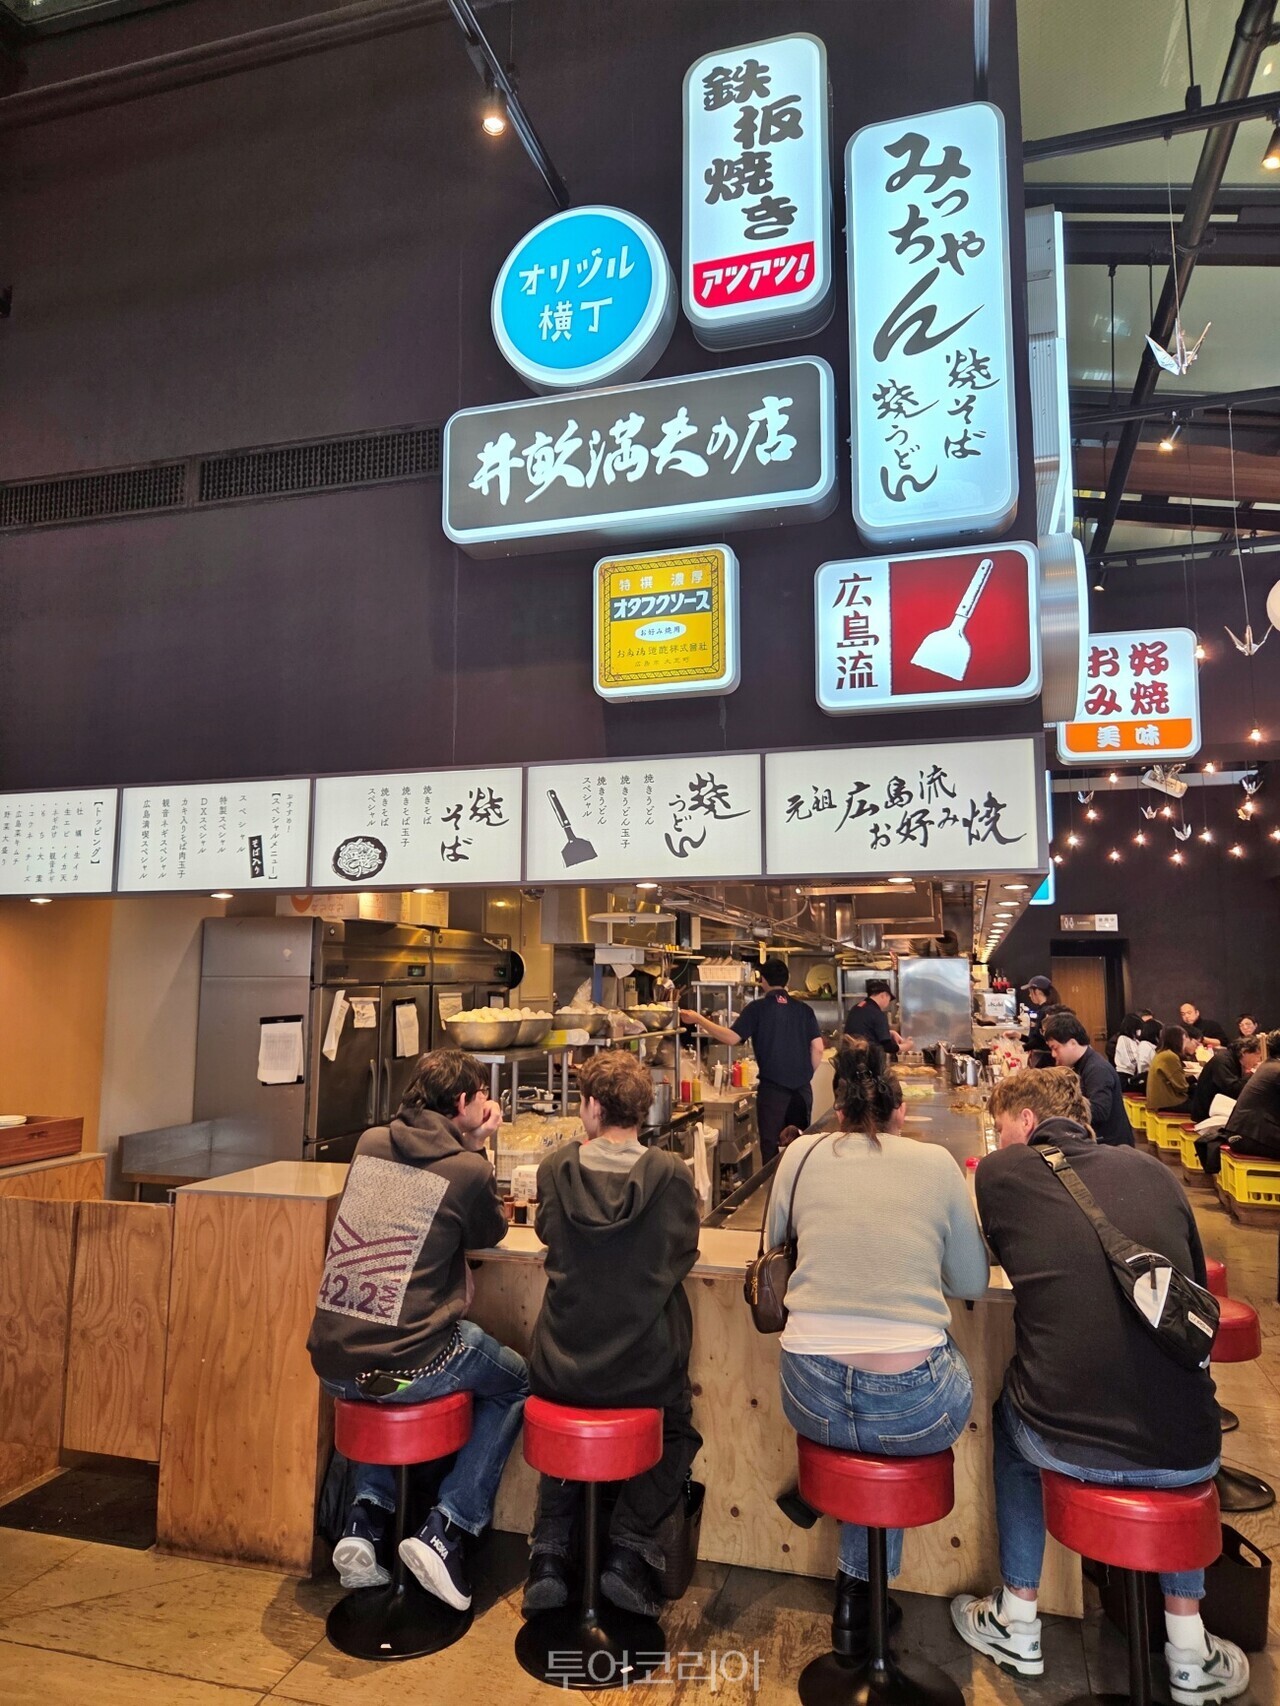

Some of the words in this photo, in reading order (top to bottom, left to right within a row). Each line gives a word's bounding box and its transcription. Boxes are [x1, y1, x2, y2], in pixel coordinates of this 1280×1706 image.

[702, 58, 804, 241] 鉄板焼き
[518, 244, 635, 296] オリヅル
[873, 132, 985, 362] みっちゃん
[538, 296, 613, 342] 横丁
[945, 347, 1000, 459] 焼そば
[872, 378, 940, 502] 焼うどん
[613, 590, 710, 619] オタフクソース
[618, 576, 653, 592] 特撰
[671, 570, 703, 587] 濃厚
[640, 625, 681, 637] お好み焼用
[831, 572, 880, 690] 広島流
[1097, 724, 1160, 748] 美味
[236, 794, 247, 853] スペシャル
[366, 788, 376, 827] スペシャル
[380, 787, 390, 827] 焼きそば
[401, 786, 412, 848] 焼きそば玉子
[422, 785, 433, 825] 焼きそば
[582, 777, 592, 818] スペシャル
[597, 776, 607, 825] 焼きうどん
[620, 774, 631, 849] 焼きうどん玉子
[643, 773, 655, 825] 焼きうどん
[870, 791, 1027, 850] お好み焼
[217, 796, 228, 853] 特製スペシャル
[440, 787, 510, 862] 焼そば
[319, 1272, 378, 1315] 42.2
[430, 1535, 449, 1560] HOKA
